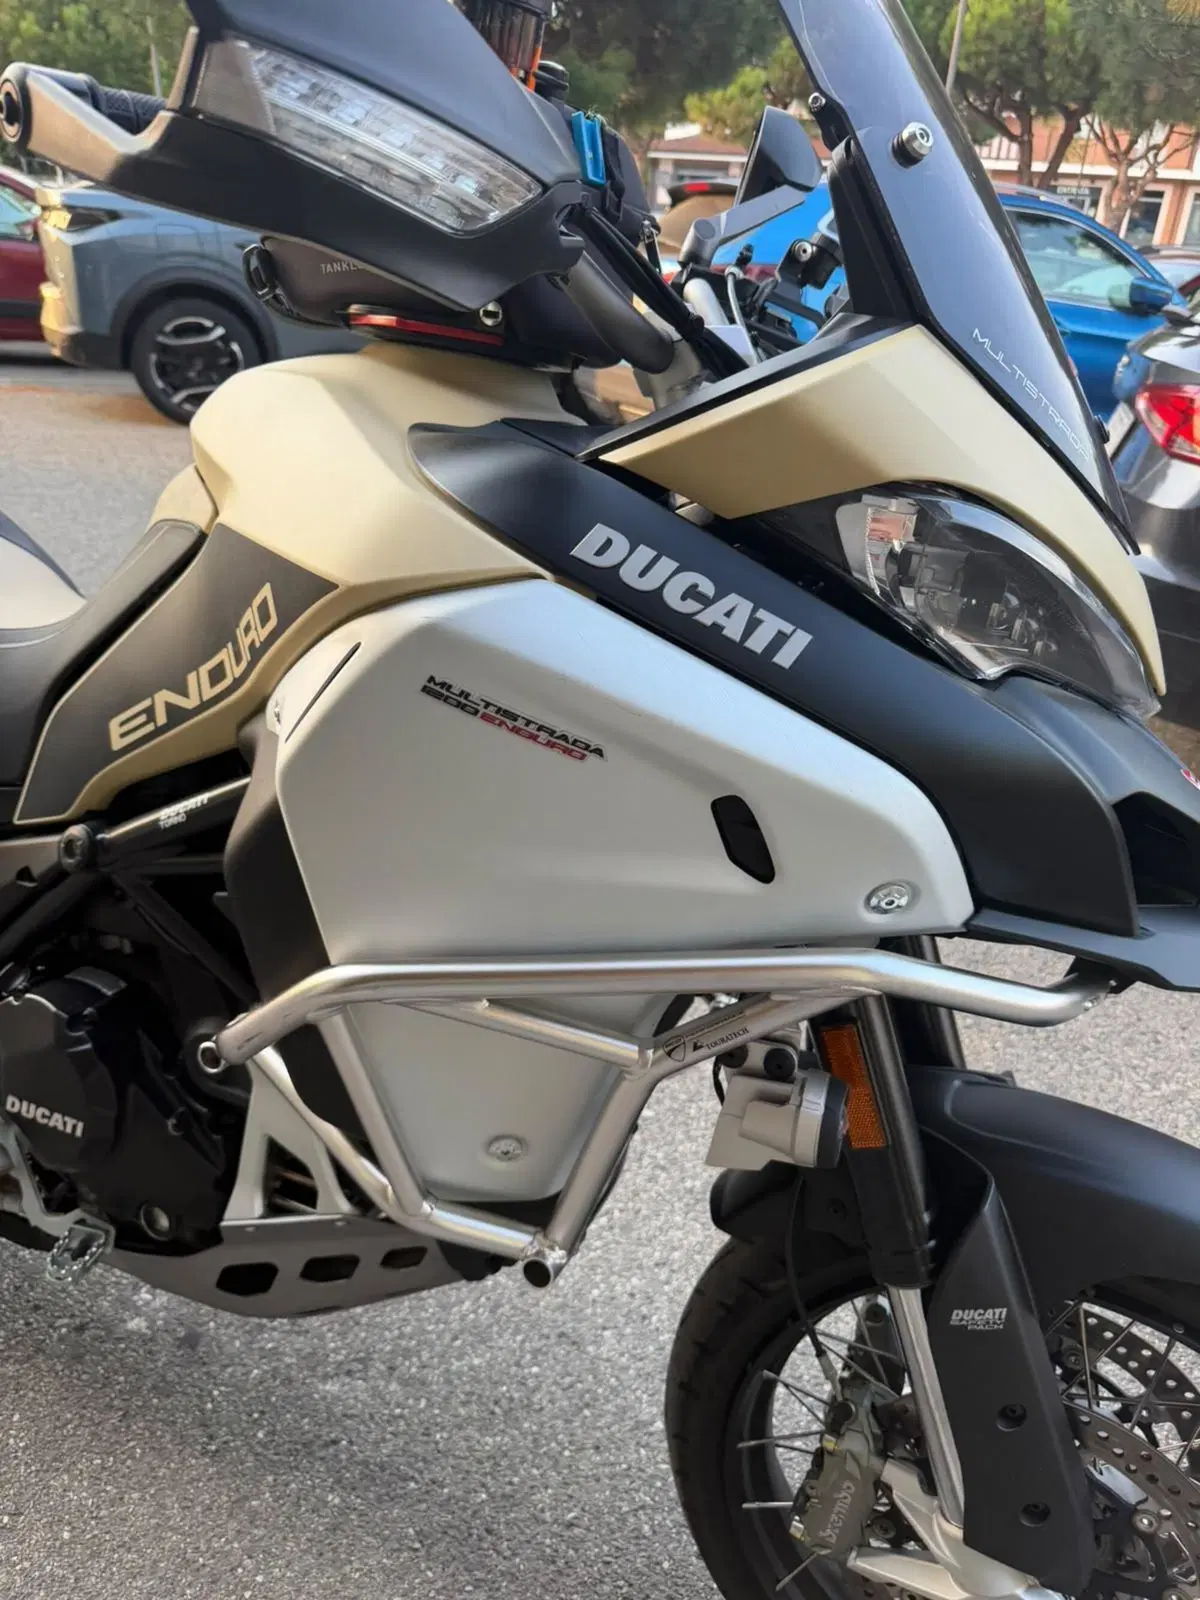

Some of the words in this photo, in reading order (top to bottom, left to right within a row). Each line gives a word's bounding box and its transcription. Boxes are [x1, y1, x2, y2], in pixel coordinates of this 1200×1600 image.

[972, 327, 1090, 462] MULTISTRADA
[569, 522, 814, 670] DUCATI
[108, 581, 278, 751] ENDURO
[426, 674, 605, 759] MULTISTRADA
[479, 711, 589, 762] ENDURO
[706, 1027, 750, 1050] TOURATECH
[5, 1093, 85, 1138] DUCATI
[951, 1307, 1008, 1321] DUCATI
